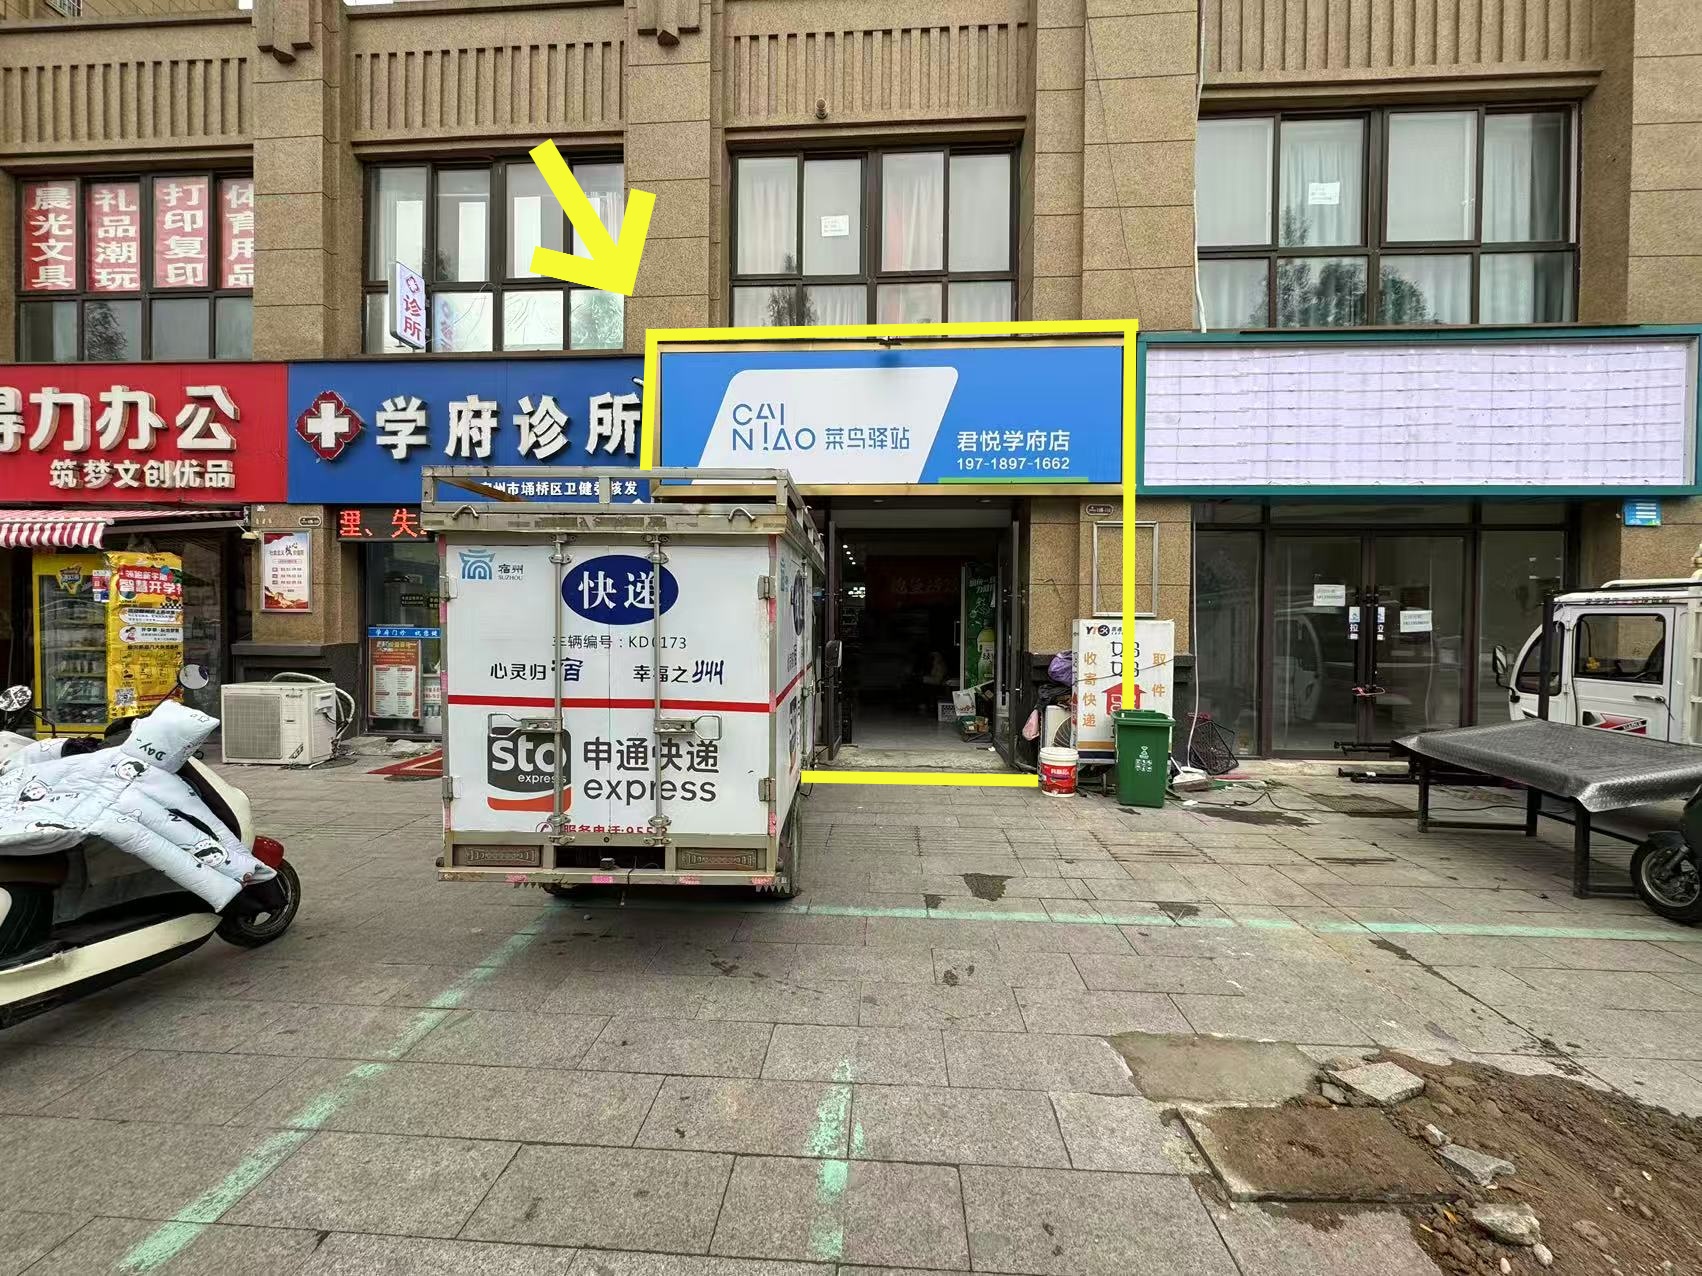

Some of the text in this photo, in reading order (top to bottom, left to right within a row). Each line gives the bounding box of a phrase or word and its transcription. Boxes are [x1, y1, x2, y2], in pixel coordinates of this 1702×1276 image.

[30, 187, 73, 288] 晨光文具
[95, 189, 139, 289] 礼品潮玩
[163, 184, 206, 285] 打印复印
[403, 294, 422, 341] 诊所
[376, 391, 641, 460] 学府诊所
[733, 403, 785, 426] CAI
[825, 426, 910, 451] 菜鸟驿站
[957, 429, 1071, 452] 君悦学府店
[49, 458, 236, 489] 筑梦文创优品
[957, 457, 1071, 470] 197-1897-1662
[498, 563, 524, 575] 宿州
[577, 571, 661, 610] 快递
[490, 657, 583, 682] 心灵归宿
[633, 659, 725, 685] 幸福之州
[1152, 652, 1167, 698] 取件
[1082, 651, 1097, 728] 收寄快递
[139, 742, 166, 761] Day
[491, 734, 567, 773] sto
[583, 736, 720, 774] 申通快递
[583, 778, 717, 806] express
